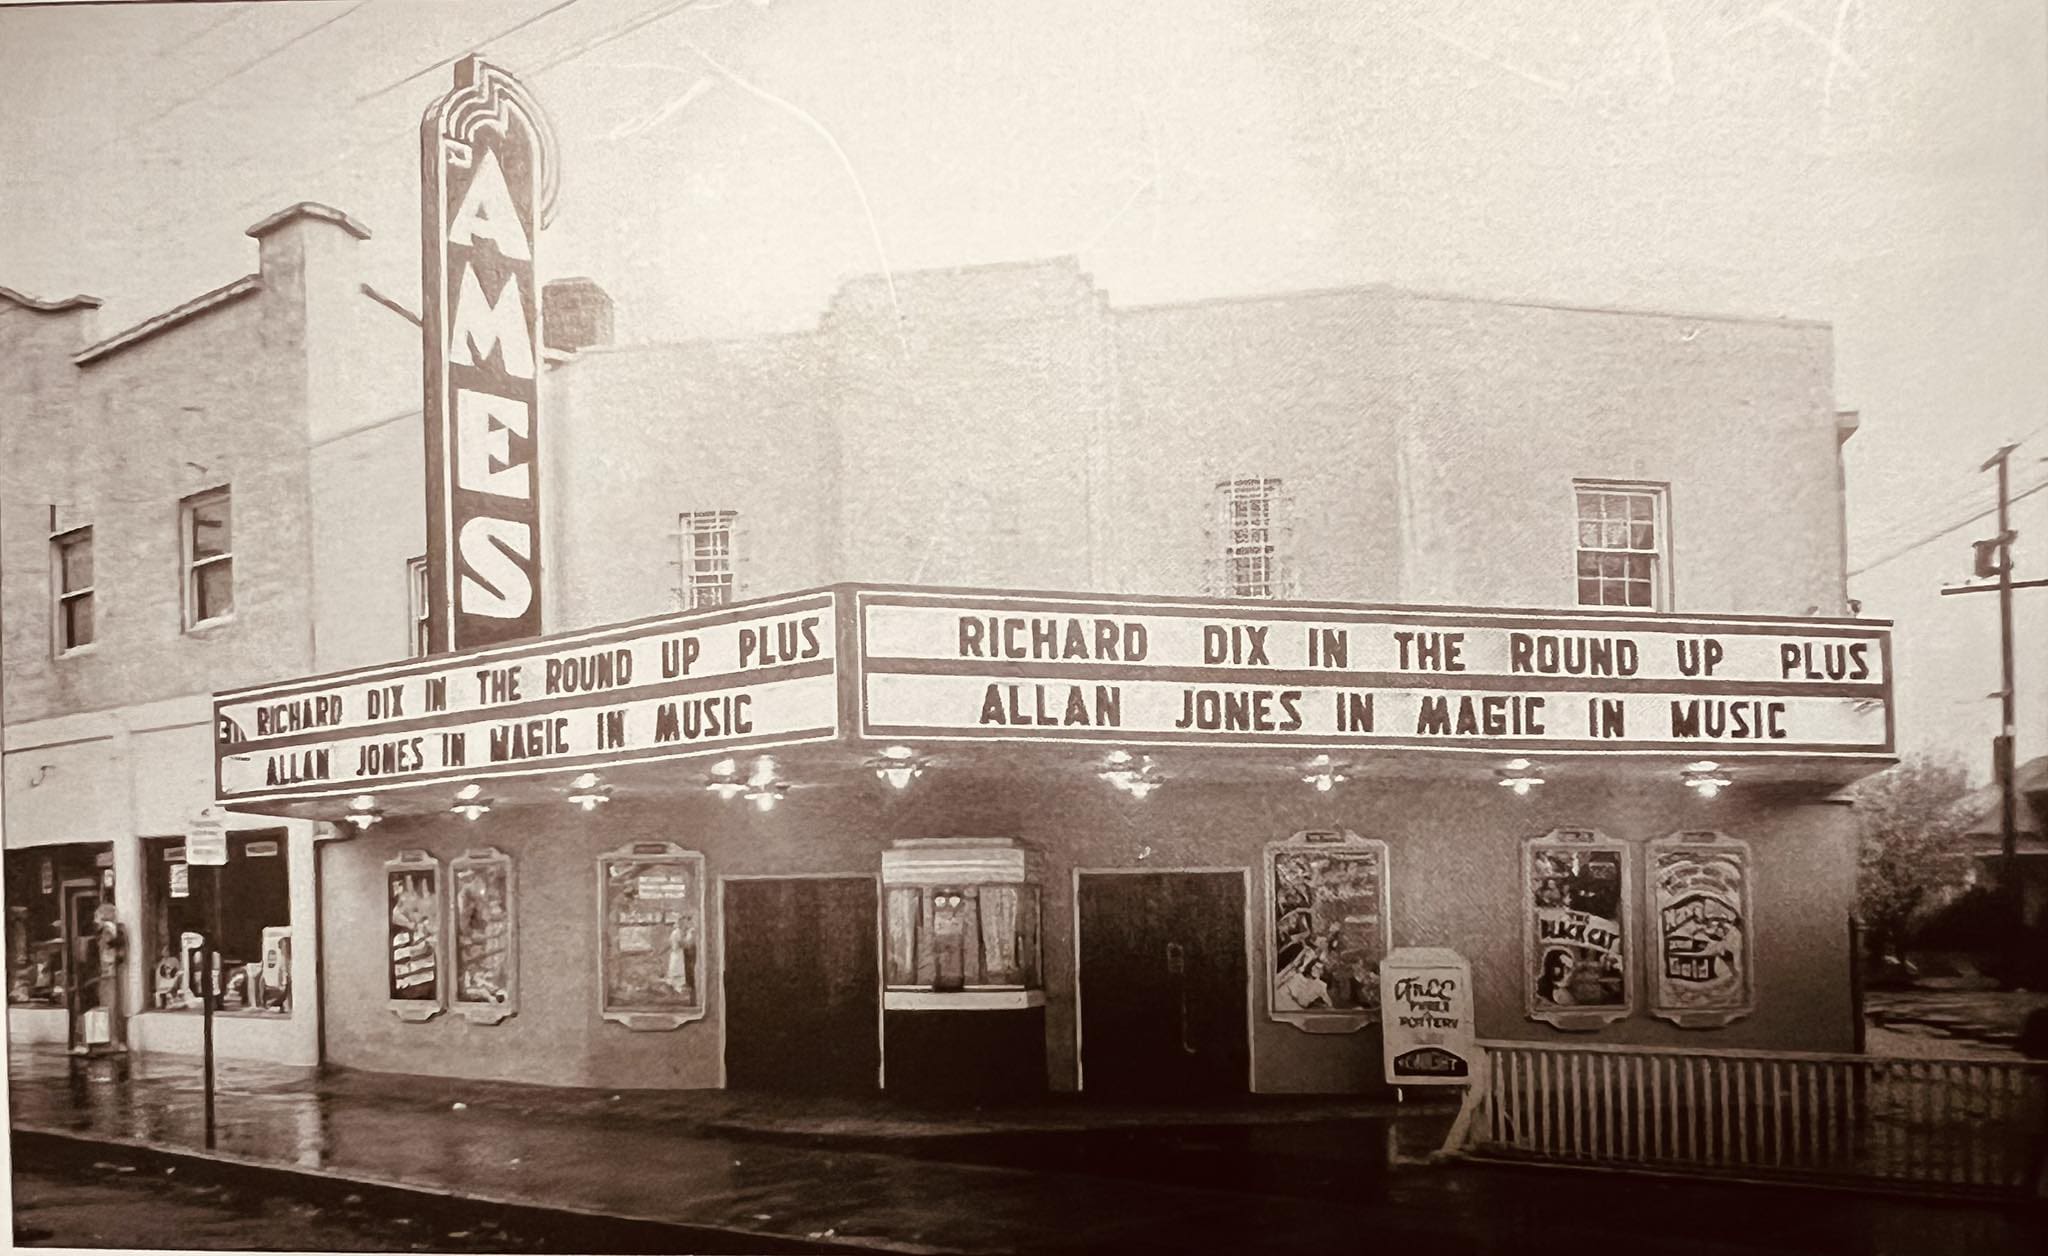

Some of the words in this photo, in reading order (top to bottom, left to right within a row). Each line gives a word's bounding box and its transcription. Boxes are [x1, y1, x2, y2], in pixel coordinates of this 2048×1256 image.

[257, 694, 343, 736] RICHARD
[367, 685, 406, 721] DIX
[425, 677, 447, 712] IN
[476, 665, 523, 705] THE
[545, 649, 633, 693] ROUND
[661, 637, 700, 680] UP
[739, 617, 821, 667] PLUS
[959, 616, 1149, 662] RICHARD
[1203, 624, 1269, 666] DIX
[1308, 628, 1348, 669] IN
[1394, 631, 1466, 672] THE
[1510, 632, 1640, 677] ROUND
[1676, 638, 1724, 677] UP
[1780, 642, 1870, 681] PLUS
[266, 748, 330, 786] ALLAN
[355, 738, 424, 777] JONES
[442, 731, 466, 768] IN
[490, 717, 570, 763] MAGIC
[597, 709, 626, 750] IN
[655, 695, 754, 743] MUSIC
[979, 683, 1122, 728] ALLAN
[1175, 688, 1303, 732] JONES
[1336, 692, 1375, 733] IN
[1416, 695, 1546, 736] MAGIC
[1588, 698, 1625, 738] IN
[1671, 700, 1788, 740] MUSIC
